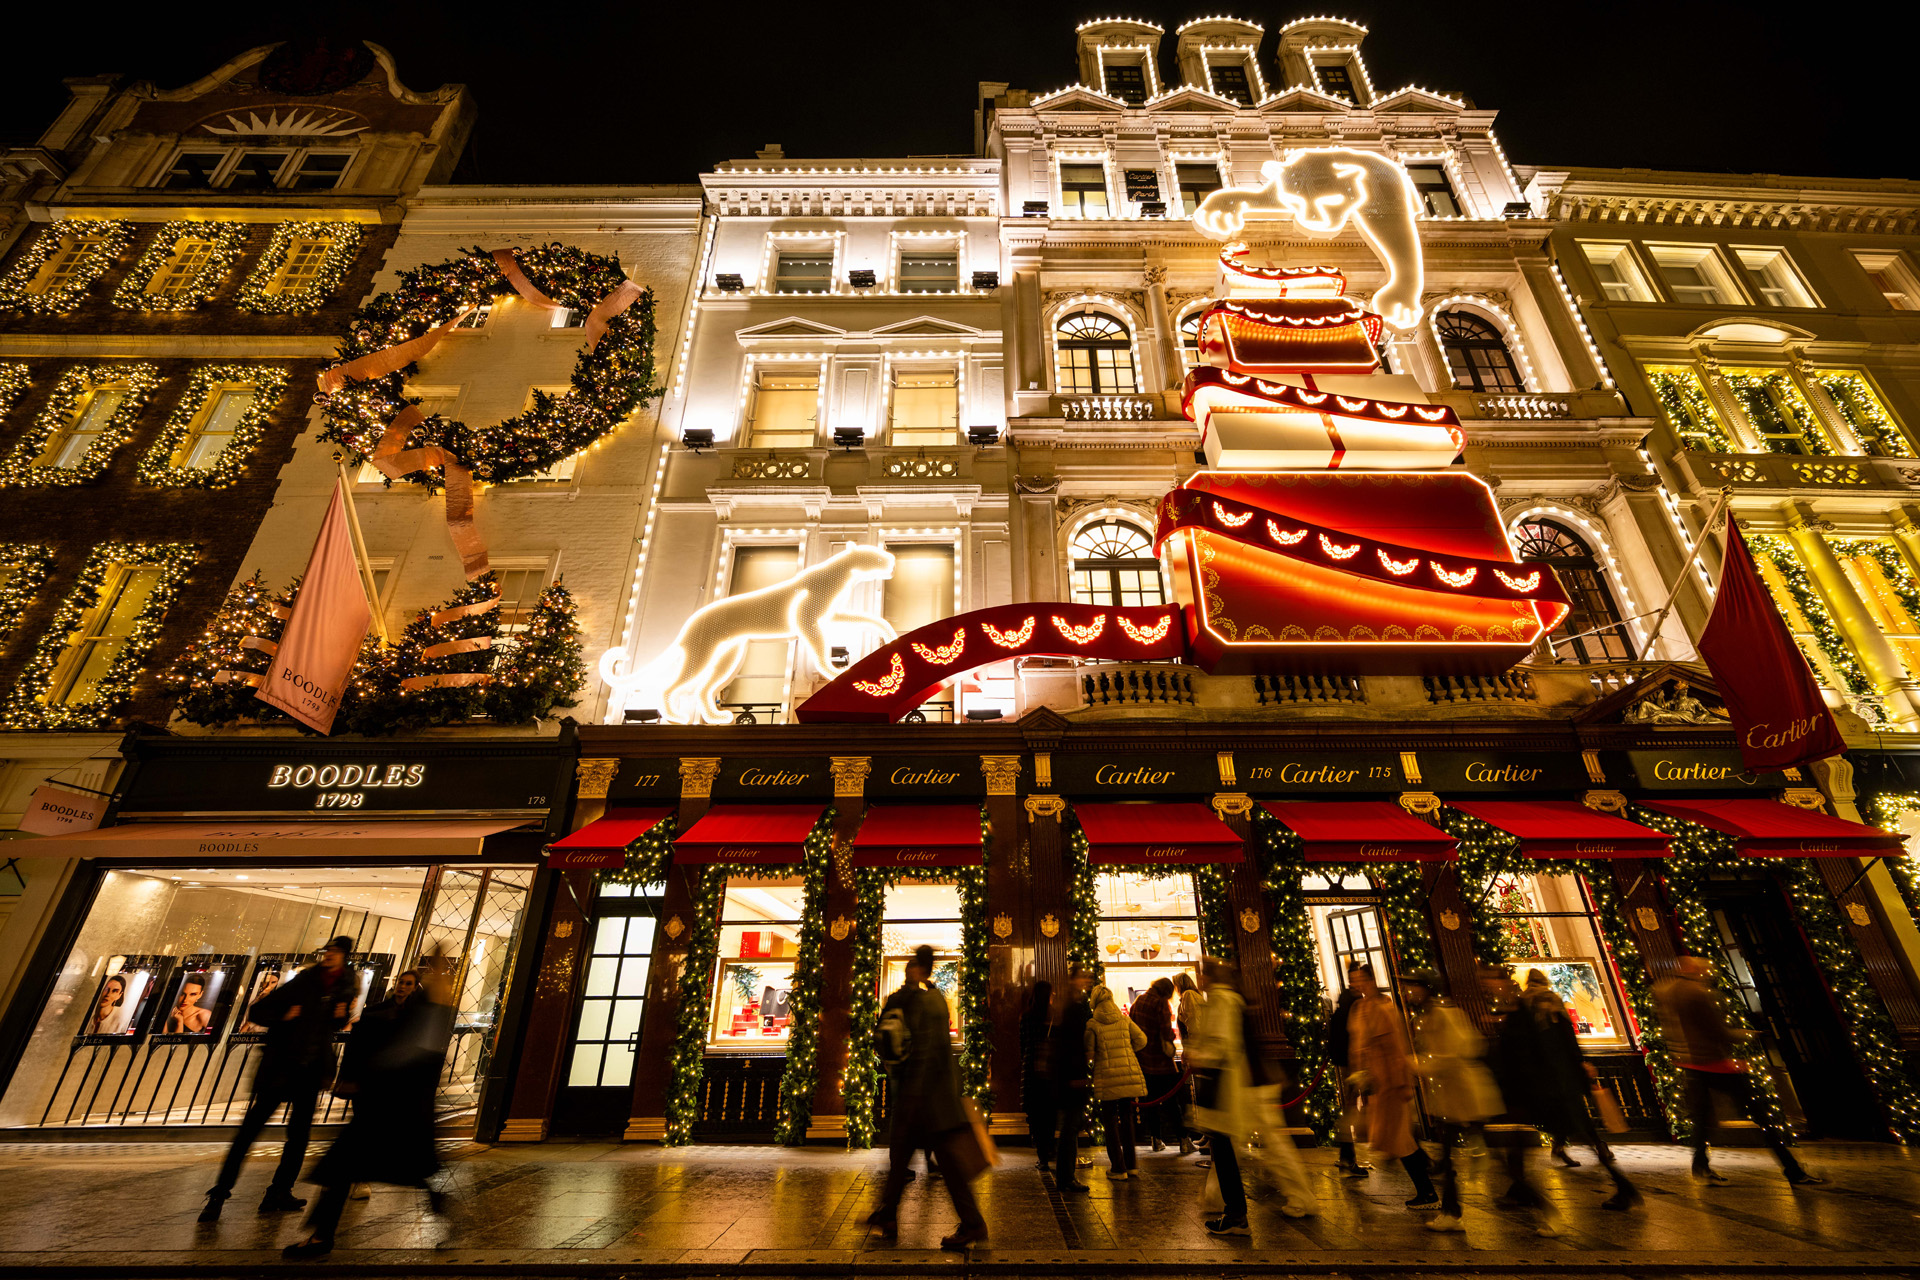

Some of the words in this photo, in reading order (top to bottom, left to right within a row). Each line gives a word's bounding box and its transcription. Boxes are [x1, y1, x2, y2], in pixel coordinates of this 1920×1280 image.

[302, 698, 320, 712] 1798
[1746, 713, 1823, 748] Cartier
[267, 764, 425, 787] BOODLES
[739, 768, 809, 786] Cartier
[891, 767, 960, 785] Cartier
[1096, 764, 1175, 785] Cartier
[1250, 767, 1273, 779] 176
[1280, 763, 1359, 783] Cartier
[1369, 767, 1391, 779] 175
[1465, 762, 1542, 782] Cartier
[1654, 760, 1732, 781] Cartier
[634, 775, 660, 787] 177
[527, 796, 546, 805] 178
[41, 802, 94, 821] BOODLES
[199, 843, 259, 853] BOODLES
[717, 845, 760, 859] Cartier
[896, 848, 939, 861] Cartier
[1146, 846, 1187, 857] Cartier
[1360, 844, 1401, 856] Cartier
[1576, 841, 1616, 854] Cartier
[565, 850, 608, 863] Cartier
